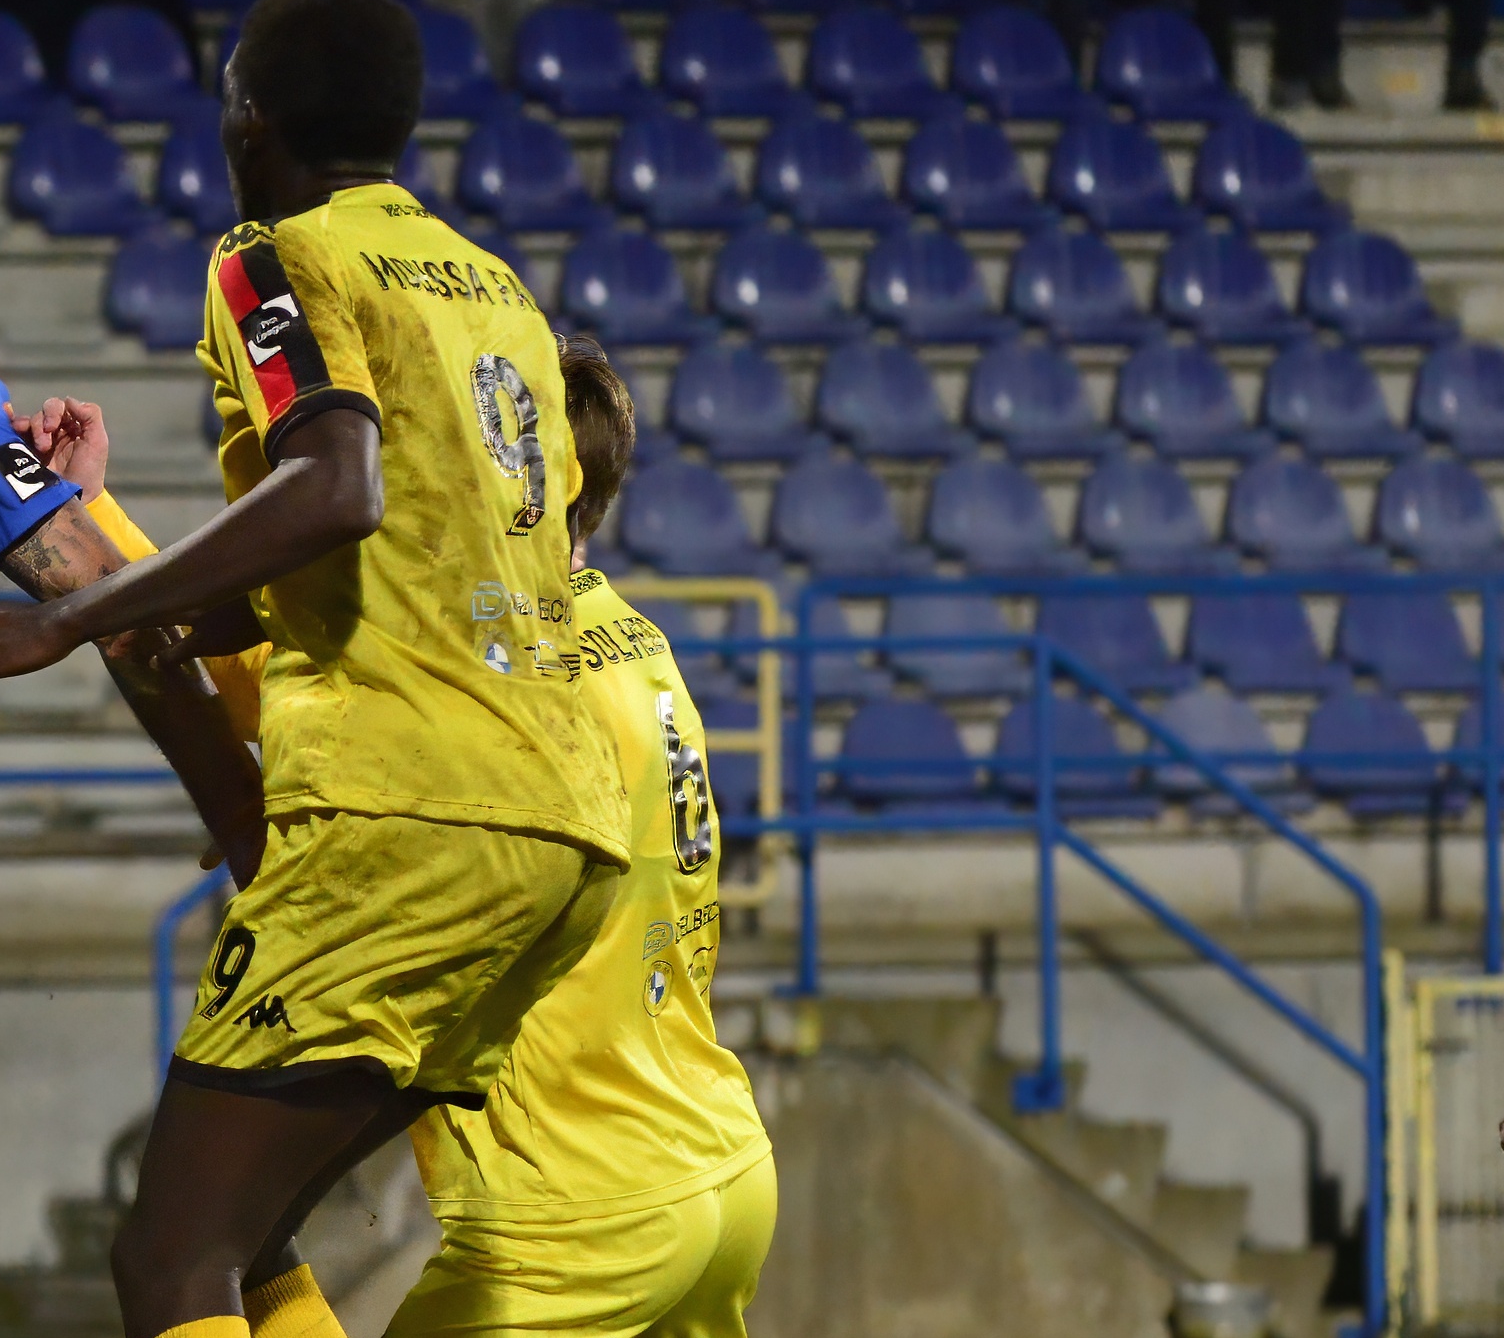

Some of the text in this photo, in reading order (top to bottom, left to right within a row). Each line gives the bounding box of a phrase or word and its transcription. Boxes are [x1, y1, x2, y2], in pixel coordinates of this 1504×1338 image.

[470, 352, 546, 538] 9
[655, 691, 713, 875] 6
[198, 926, 256, 1021] 9
